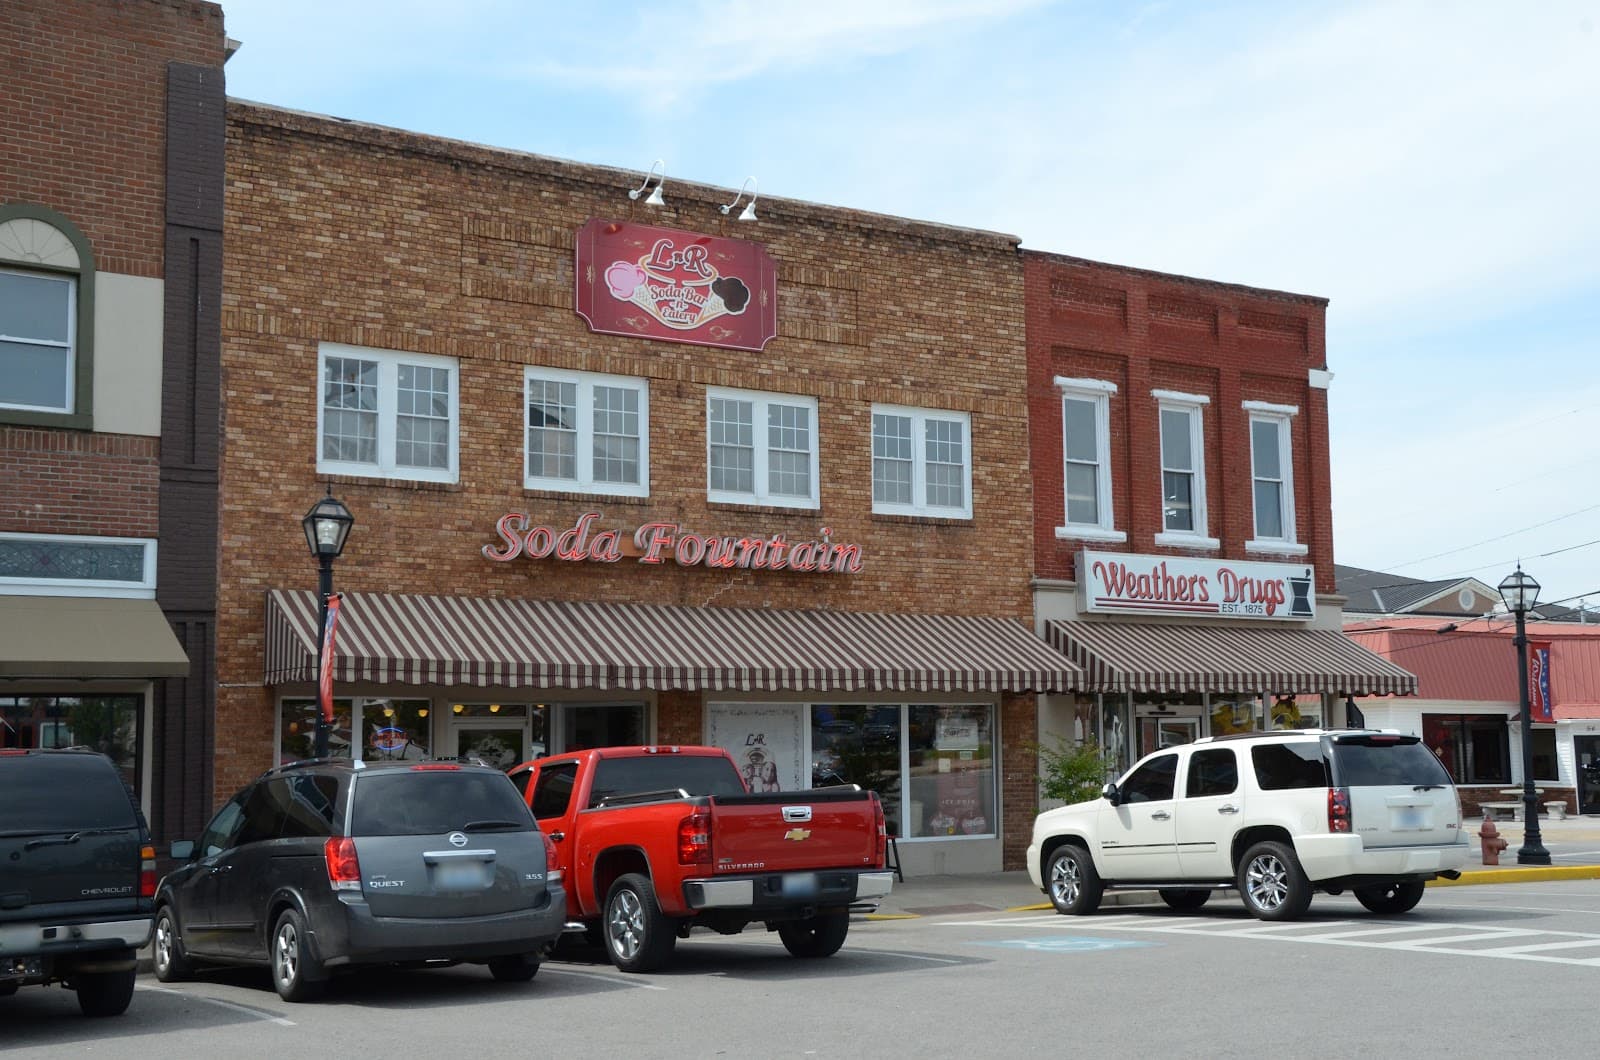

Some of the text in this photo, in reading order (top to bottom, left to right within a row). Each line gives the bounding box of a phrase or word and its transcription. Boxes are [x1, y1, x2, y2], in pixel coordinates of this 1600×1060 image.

[651, 285, 706, 305] Soda Bar
[662, 307, 696, 323] Eatery
[481, 512, 862, 574] Soda Fountain
[1092, 561, 1285, 616] Weathers Drugs
[1221, 603, 1263, 614] EST. 1875
[81, 886, 133, 895] CHEVROLET
[369, 880, 406, 889] QUEST
